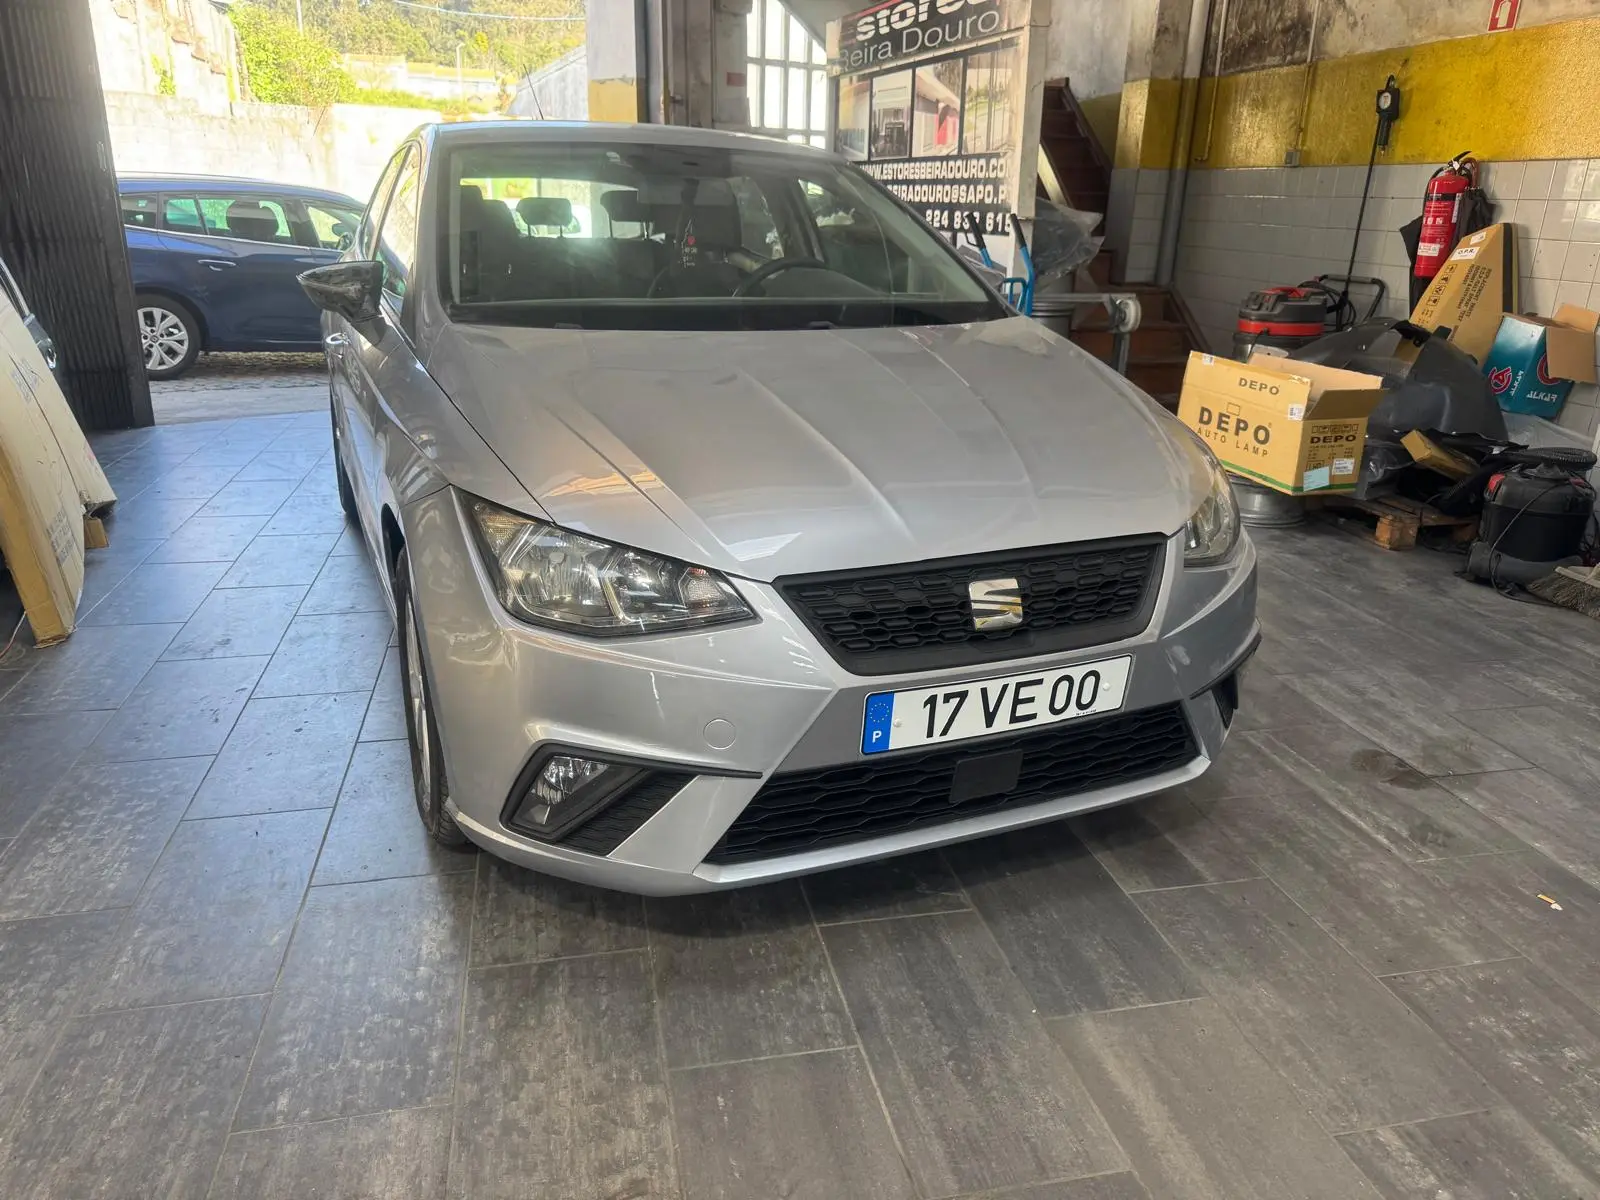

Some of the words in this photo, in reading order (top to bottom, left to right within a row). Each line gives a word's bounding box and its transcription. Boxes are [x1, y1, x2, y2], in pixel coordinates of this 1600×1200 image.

[902, 11, 1000, 53] Douro
[1238, 377, 1280, 395] DEPO
[1199, 406, 1270, 445] DEPO
[1310, 434, 1356, 444] DEPO
[1196, 427, 1227, 444] AUTO
[1235, 440, 1269, 457] LAMP
[923, 689, 969, 738] 17
[980, 678, 1044, 728] VE
[1049, 669, 1101, 716] 00
[872, 730, 882, 743] P
